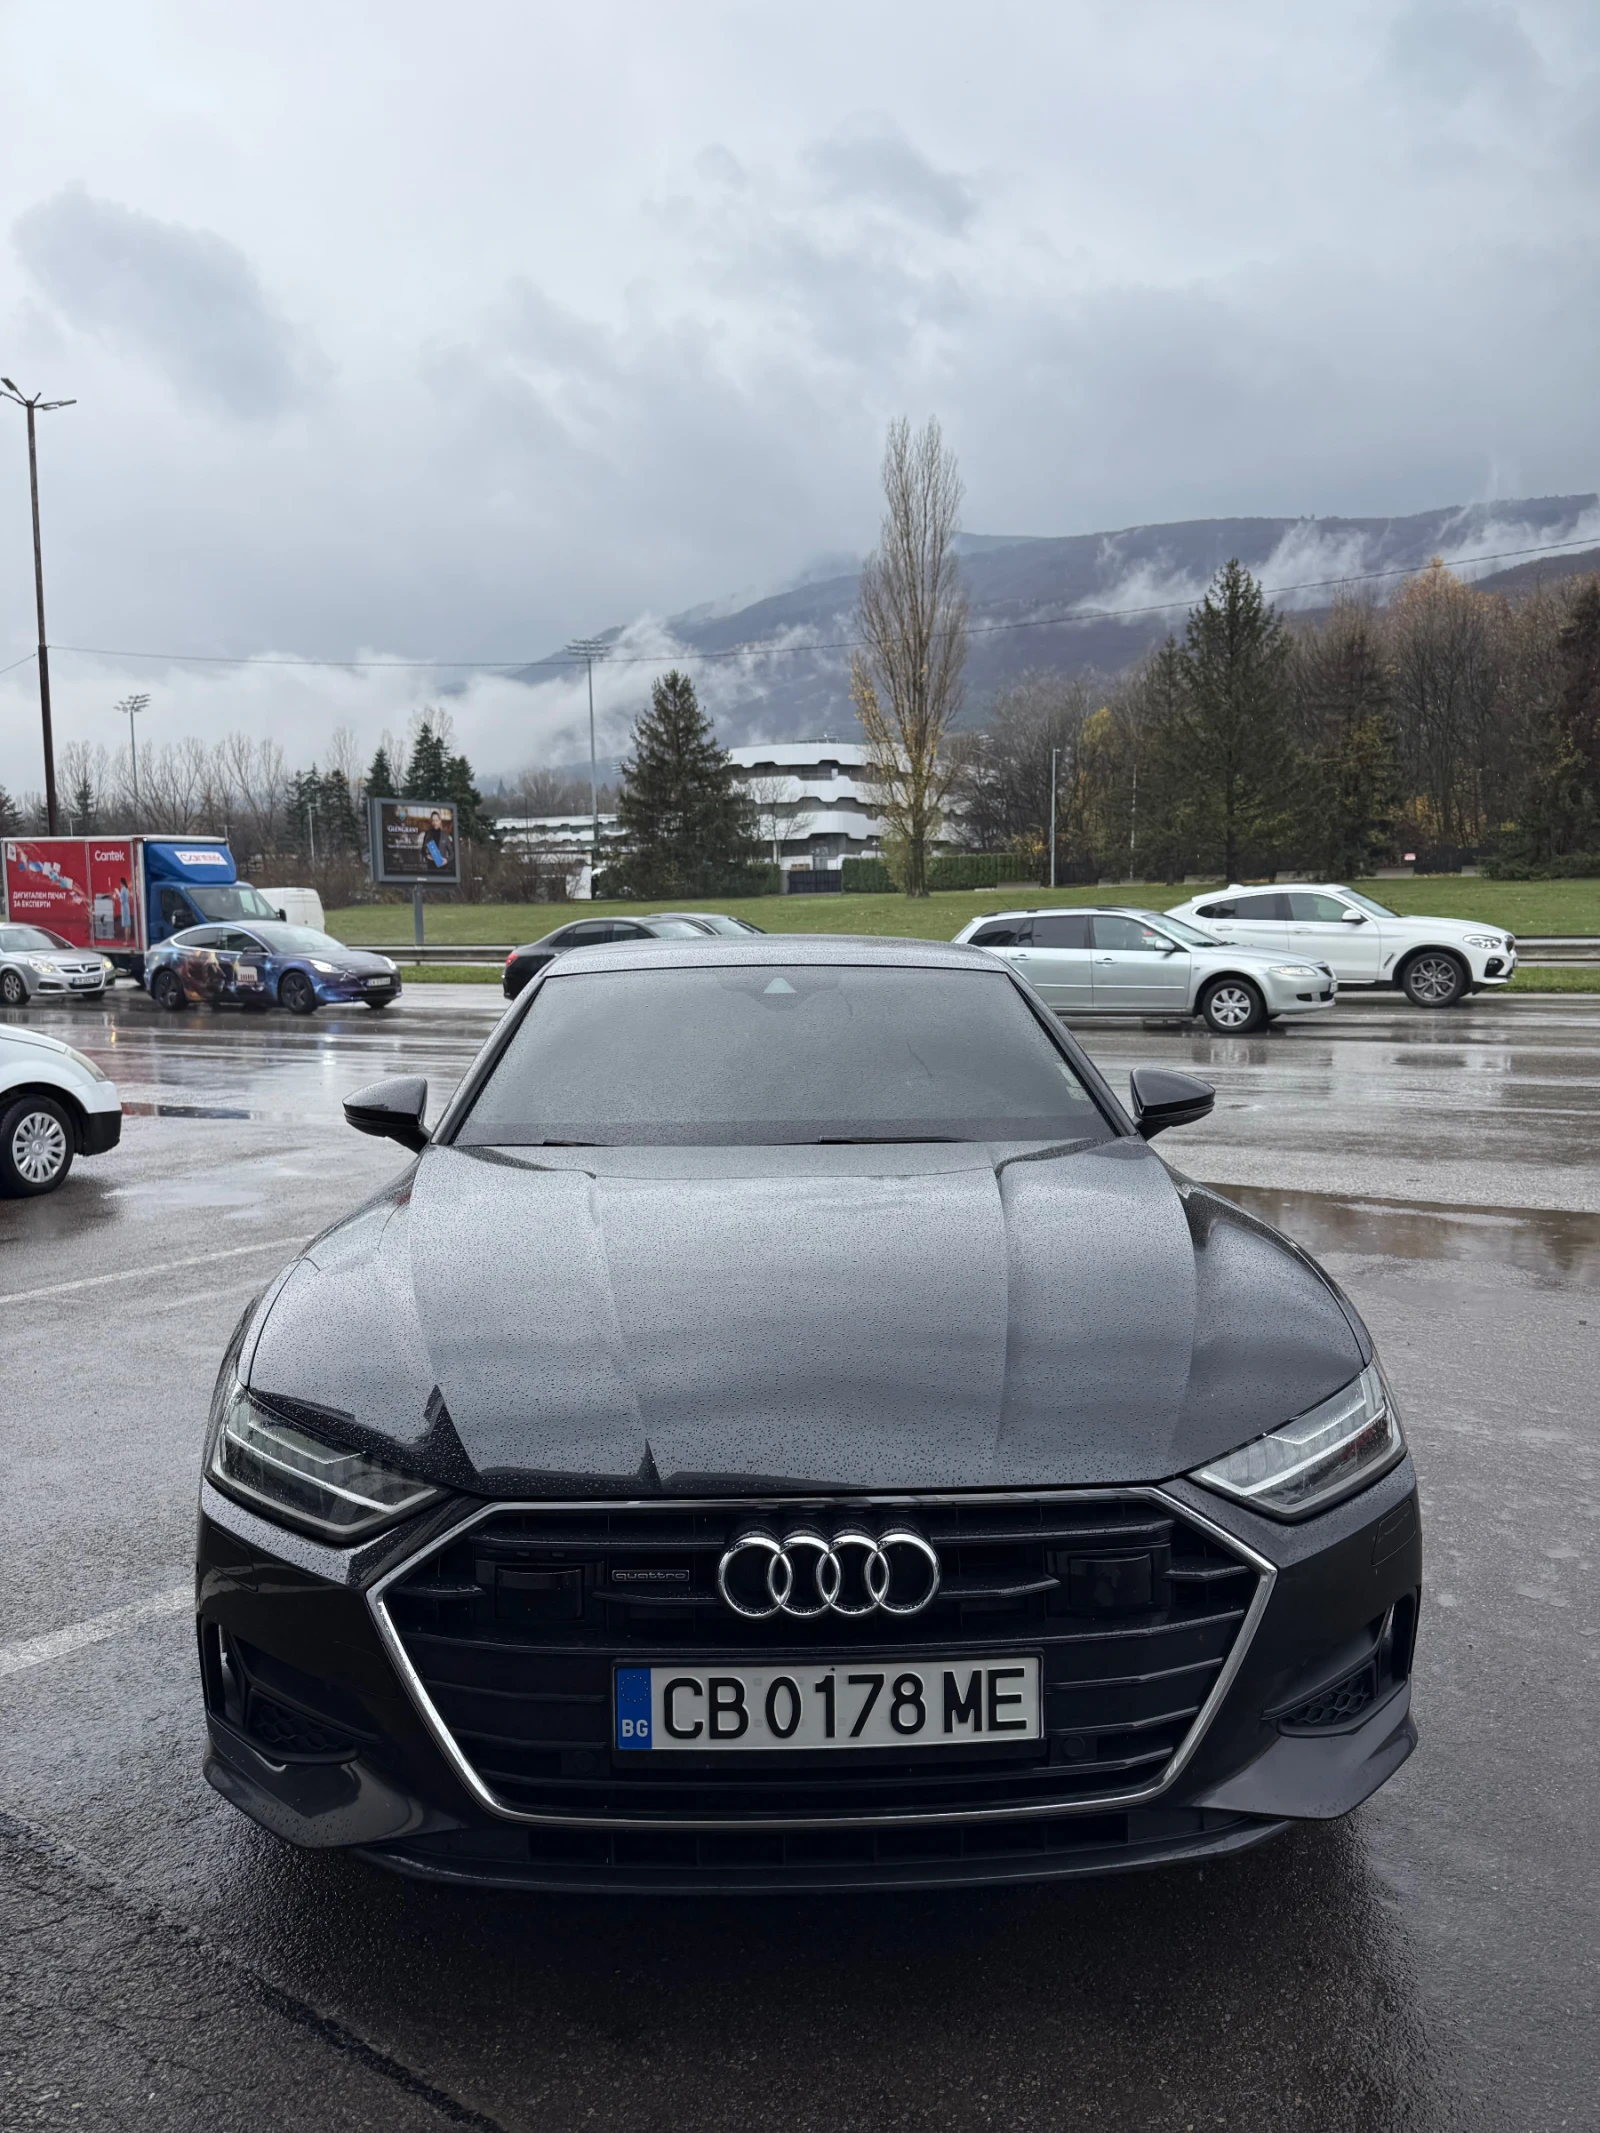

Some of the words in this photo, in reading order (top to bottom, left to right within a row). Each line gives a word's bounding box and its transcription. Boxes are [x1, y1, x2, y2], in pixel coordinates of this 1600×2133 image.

[94, 850, 125, 861] Cantek
[13, 891, 47, 899] ДИГИТАЛЕН
[48, 892, 67, 900] ПЕЧАТ
[616, 1572, 686, 1580] quattro
[663, 1676, 749, 1740] CB
[765, 1672, 926, 1738] 0178
[943, 1667, 1028, 1733] ME
[622, 1719, 648, 1737] BG
